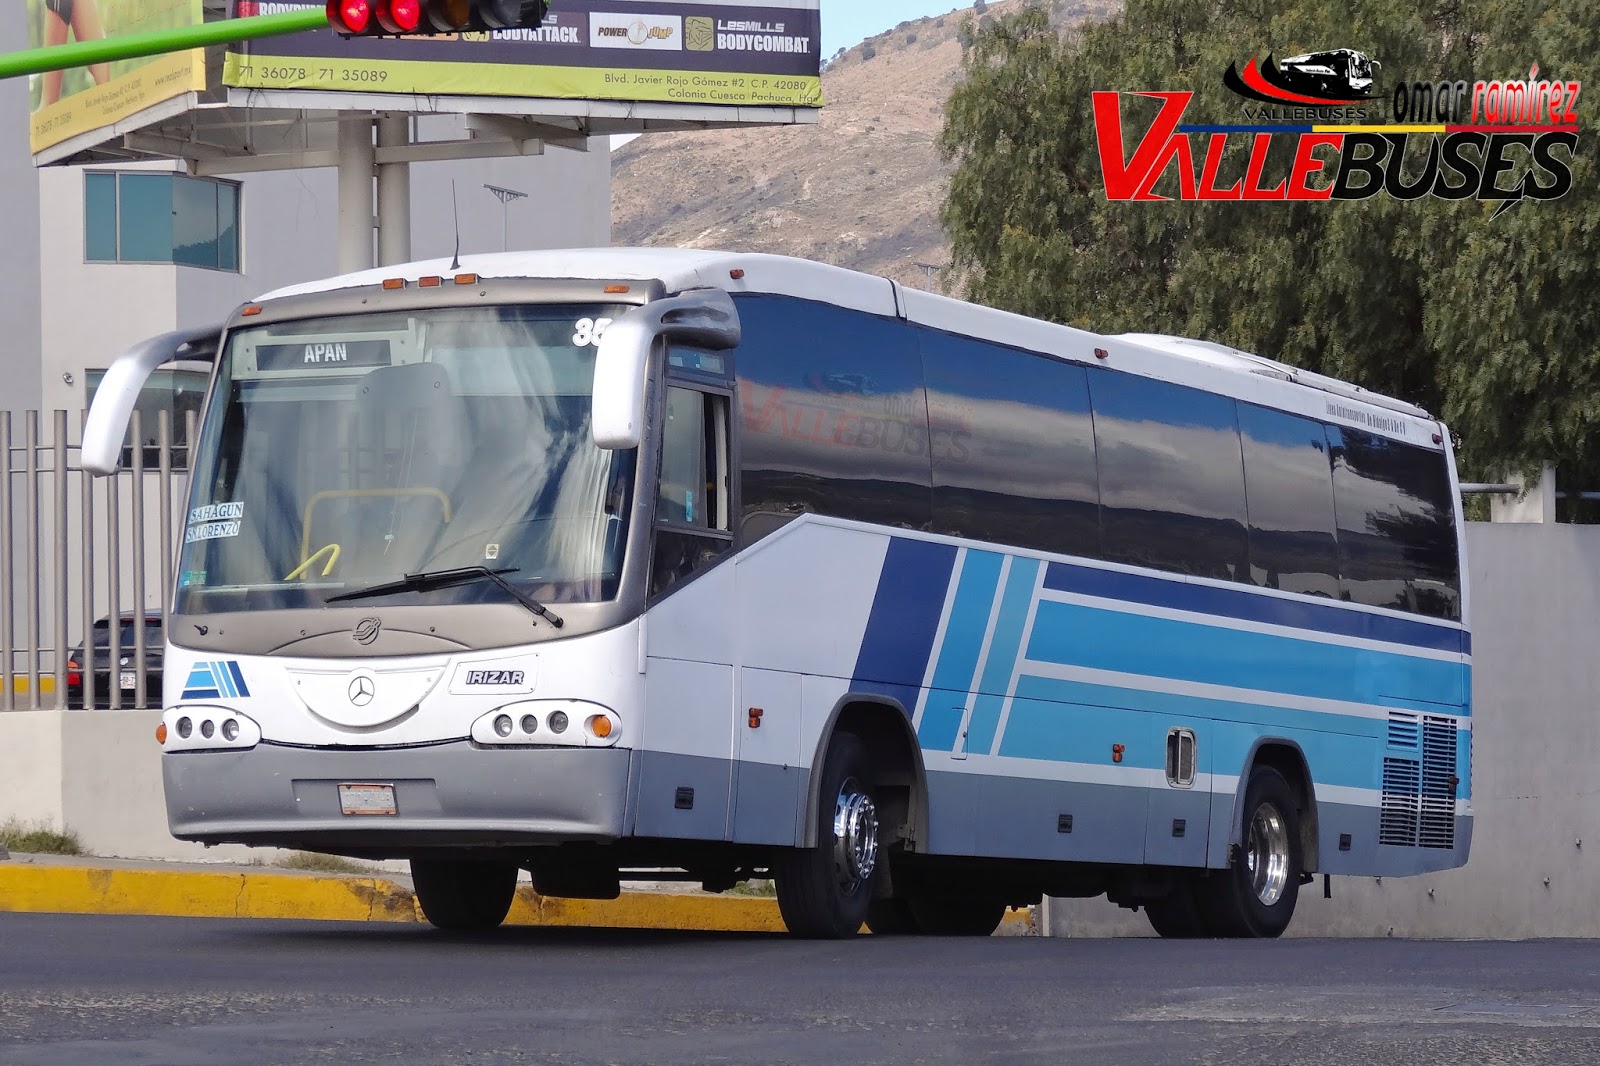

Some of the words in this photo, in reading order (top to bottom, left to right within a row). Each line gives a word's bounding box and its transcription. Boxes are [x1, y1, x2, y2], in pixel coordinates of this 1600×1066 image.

[259, 2, 327, 16] BODY
[597, 26, 628, 37] POWER
[647, 26, 673, 39] JUMP
[239, 66, 253, 78] 71
[261, 66, 306, 80] 36078
[319, 69, 334, 80] 71
[341, 69, 388, 82] 35089
[604, 73, 630, 84] Blvd.
[633, 74, 662, 84] Javier
[666, 75, 689, 87] Rojo
[692, 76, 728, 87] Gómez
[731, 78, 745, 88] #2
[751, 79, 769, 89] C.P.
[773, 79, 806, 90] 42080
[667, 88, 707, 99] Colonia
[709, 89, 746, 100] Cuesco
[304, 342, 347, 363] APAN
[190, 503, 243, 520] SAHAGUN
[197, 524, 239, 539] LORENZO
[466, 670, 525, 685] IRIZAR
